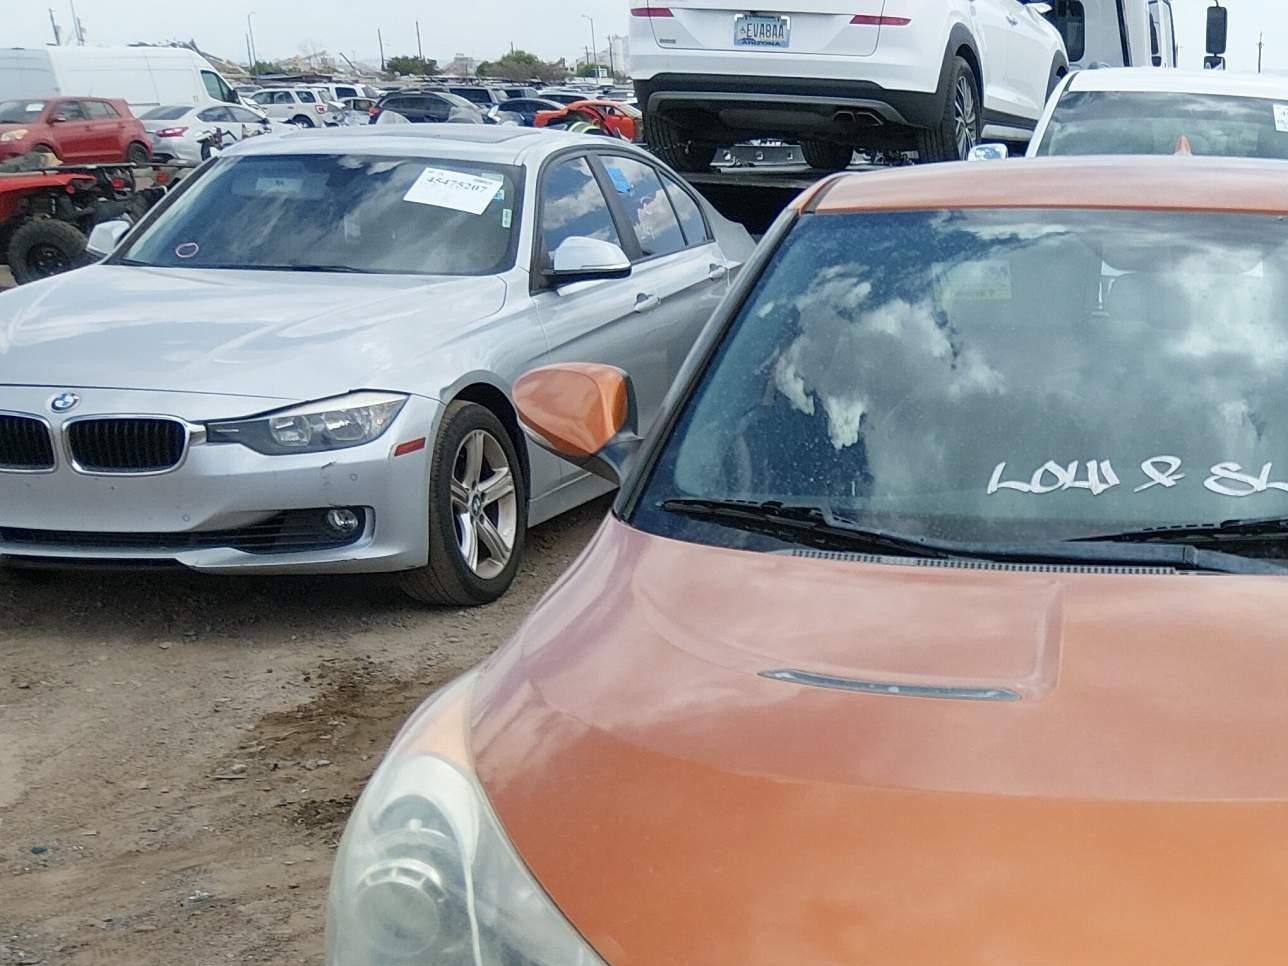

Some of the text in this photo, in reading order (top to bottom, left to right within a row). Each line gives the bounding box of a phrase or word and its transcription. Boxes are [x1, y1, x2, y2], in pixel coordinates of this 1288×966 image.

[746, 23, 784, 39] EVA8AA
[987, 459, 1120, 495] LOW
[1134, 455, 1185, 493] &
